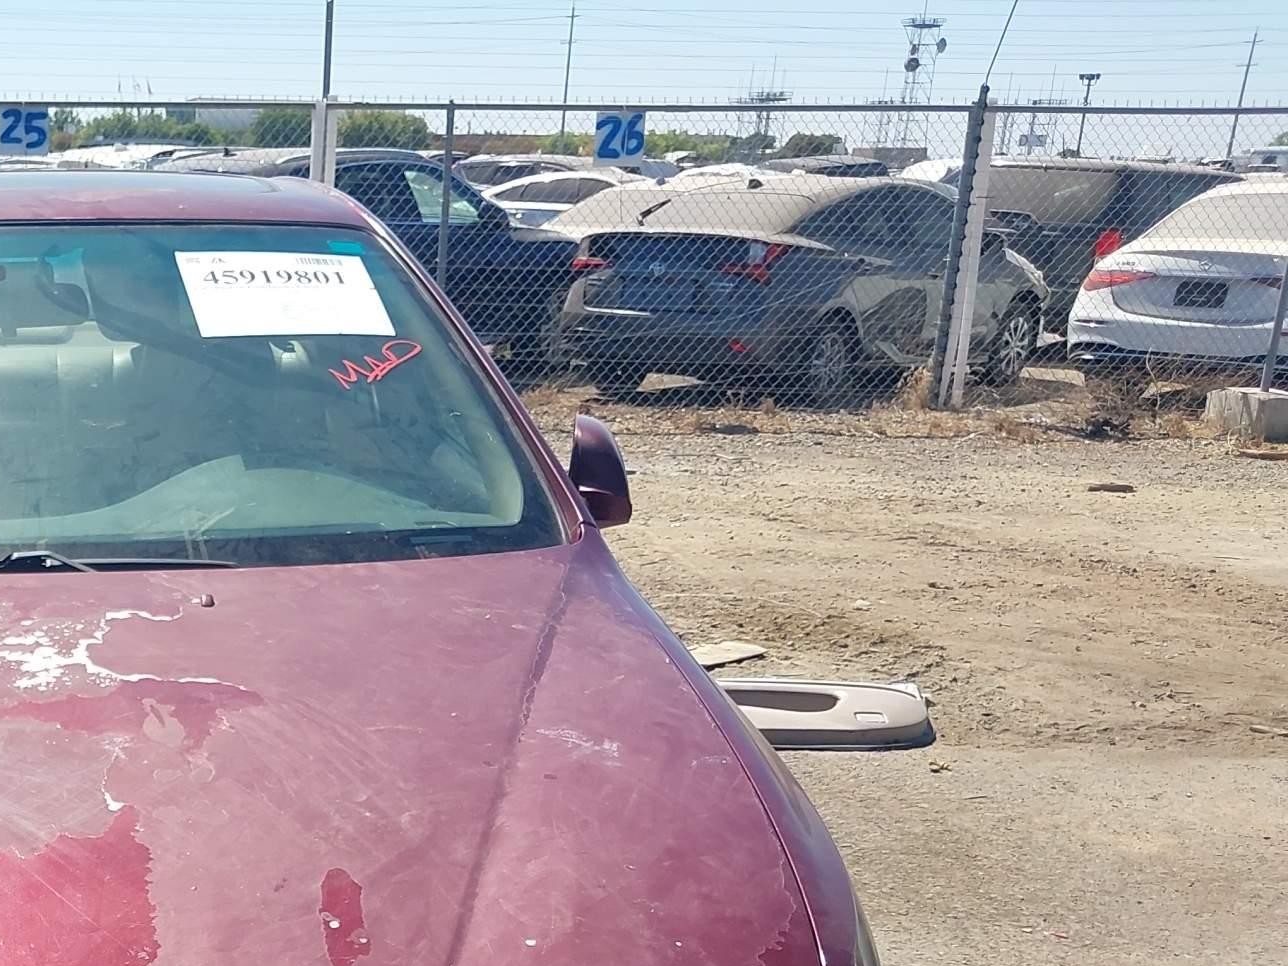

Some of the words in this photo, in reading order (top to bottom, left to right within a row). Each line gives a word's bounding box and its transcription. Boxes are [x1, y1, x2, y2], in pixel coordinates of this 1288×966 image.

[0, 108, 48, 149] 25
[596, 113, 645, 159] 26
[203, 269, 345, 285] 45919801
